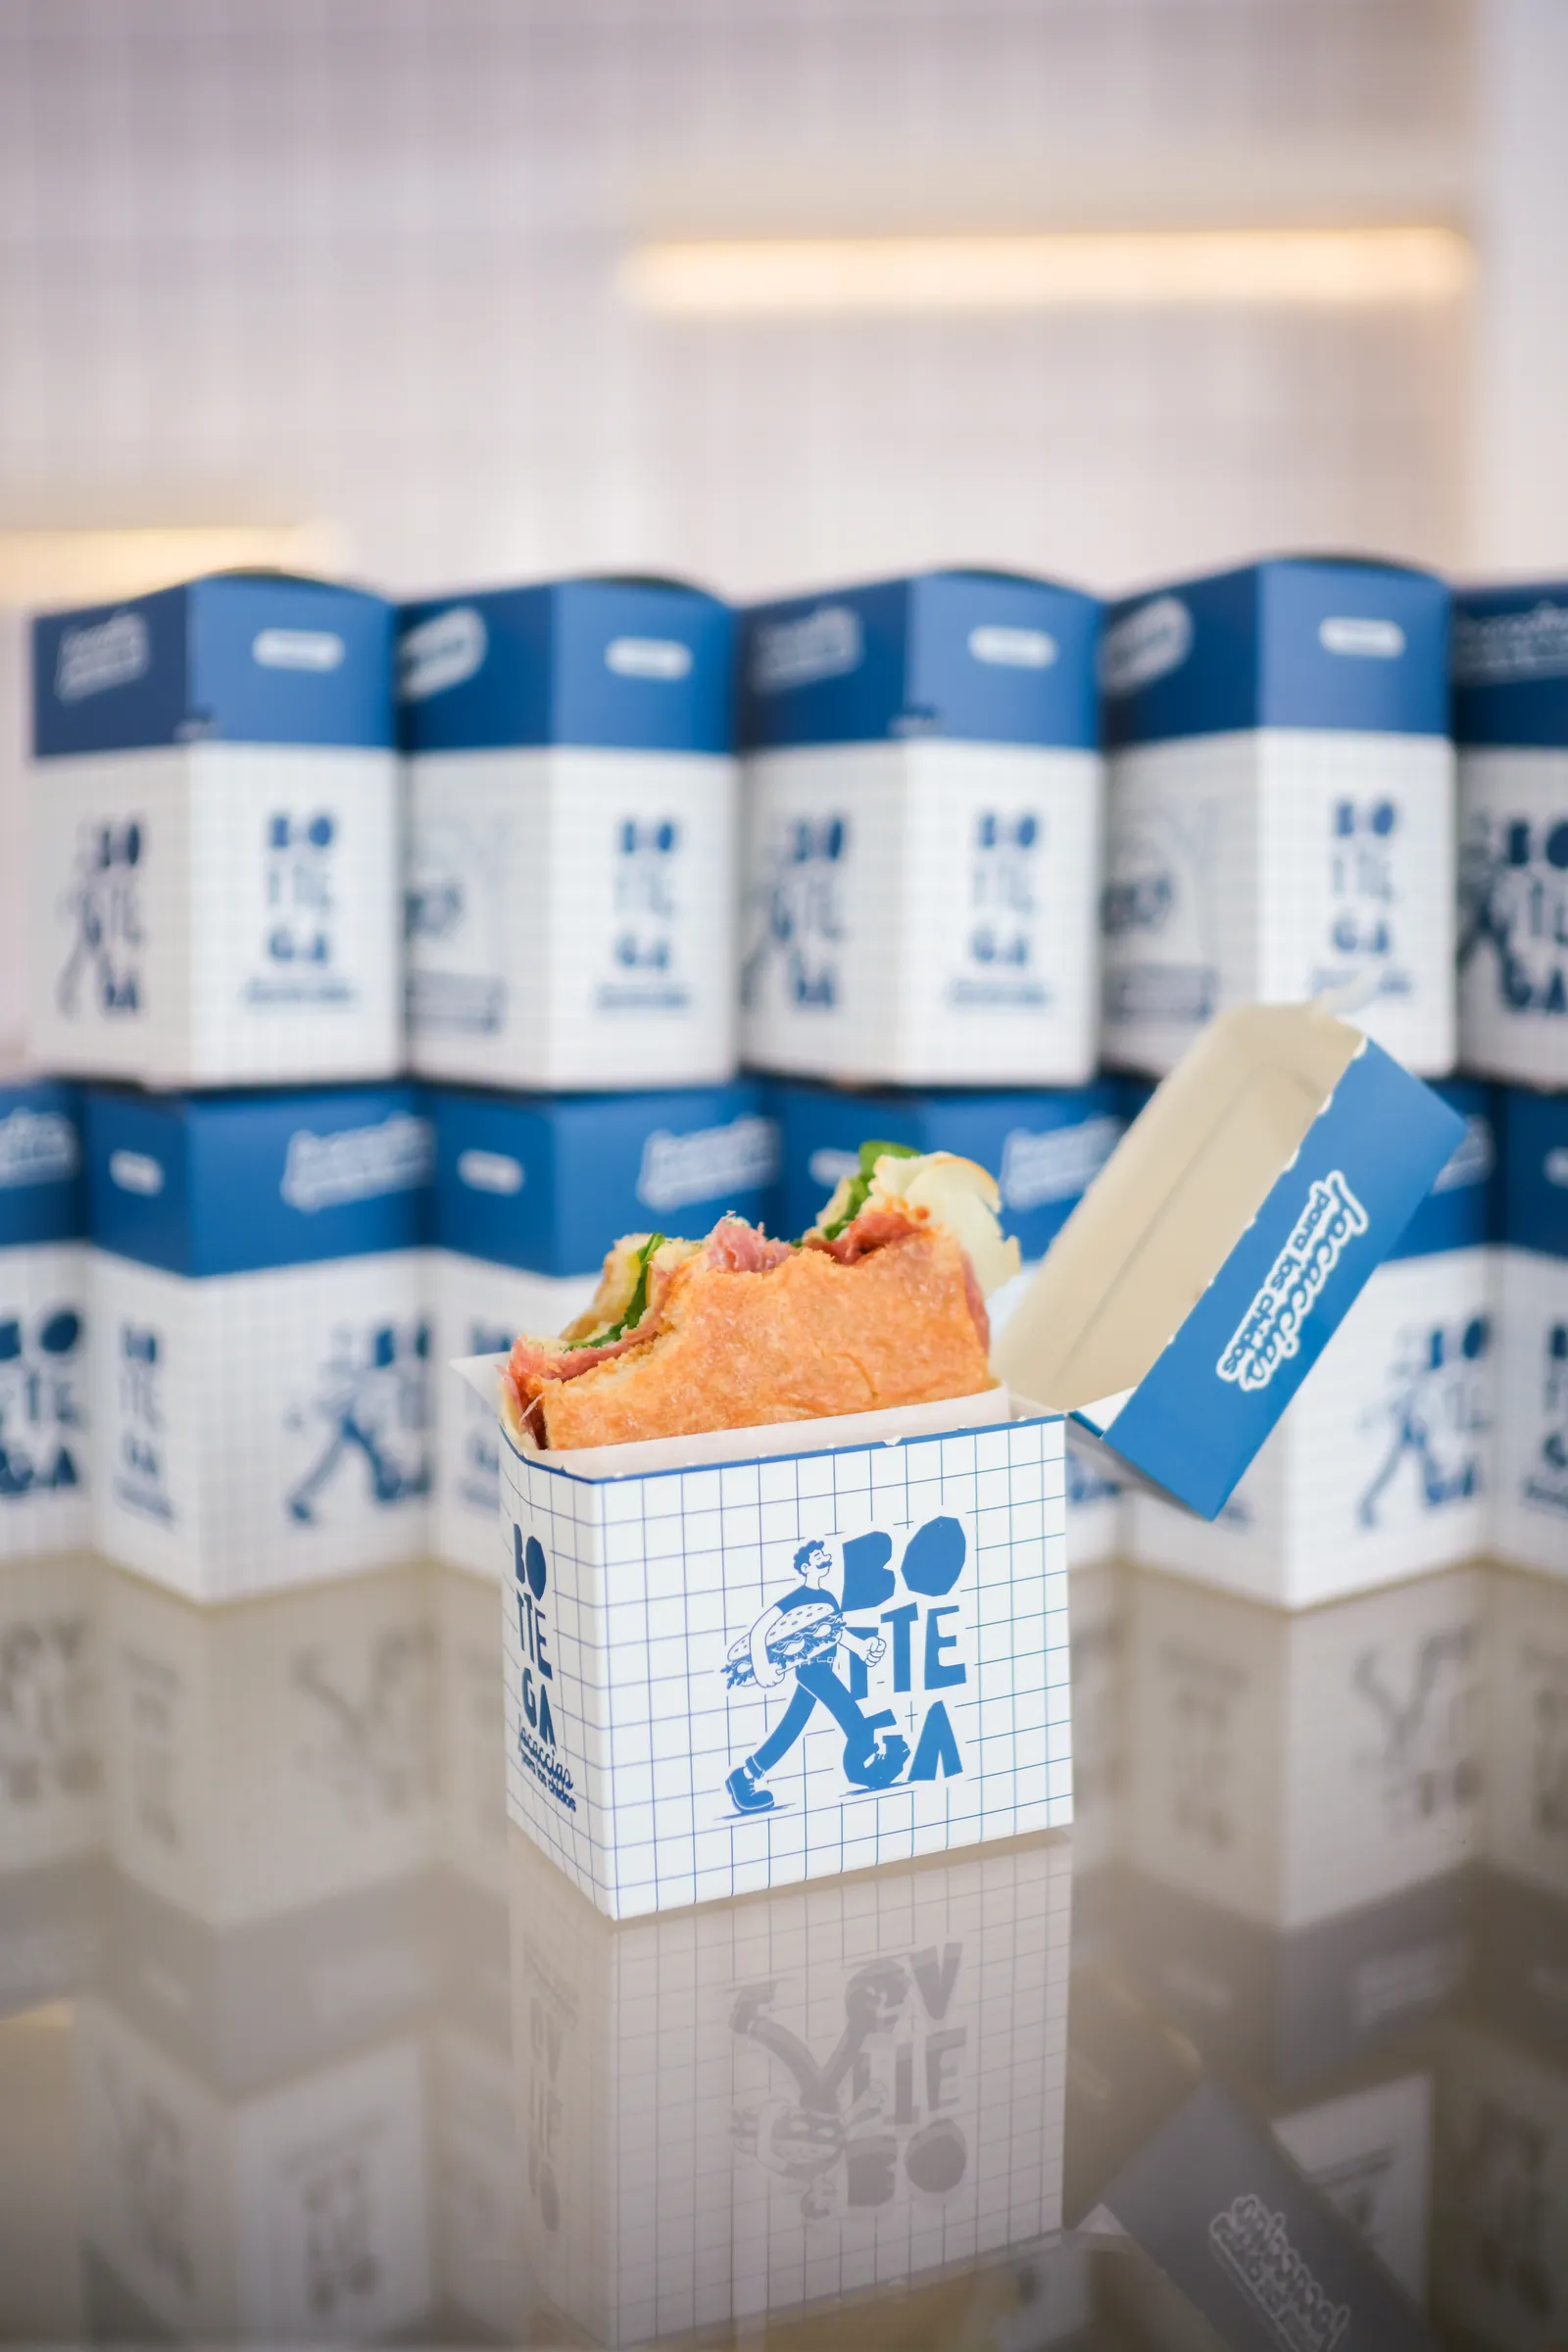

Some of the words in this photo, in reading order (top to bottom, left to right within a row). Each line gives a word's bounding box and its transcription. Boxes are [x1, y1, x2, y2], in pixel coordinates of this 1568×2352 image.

[1293, 1189, 1331, 1251] para
[1270, 1252, 1302, 1291] los
[1223, 1293, 1275, 1374] chidos
[514, 1523, 547, 1601] BO
[840, 1515, 966, 1612] BO
[516, 1588, 553, 1681] TTE
[845, 1601, 967, 1700] TTE
[521, 1667, 557, 1752] GA
[843, 1700, 963, 1789] GA
